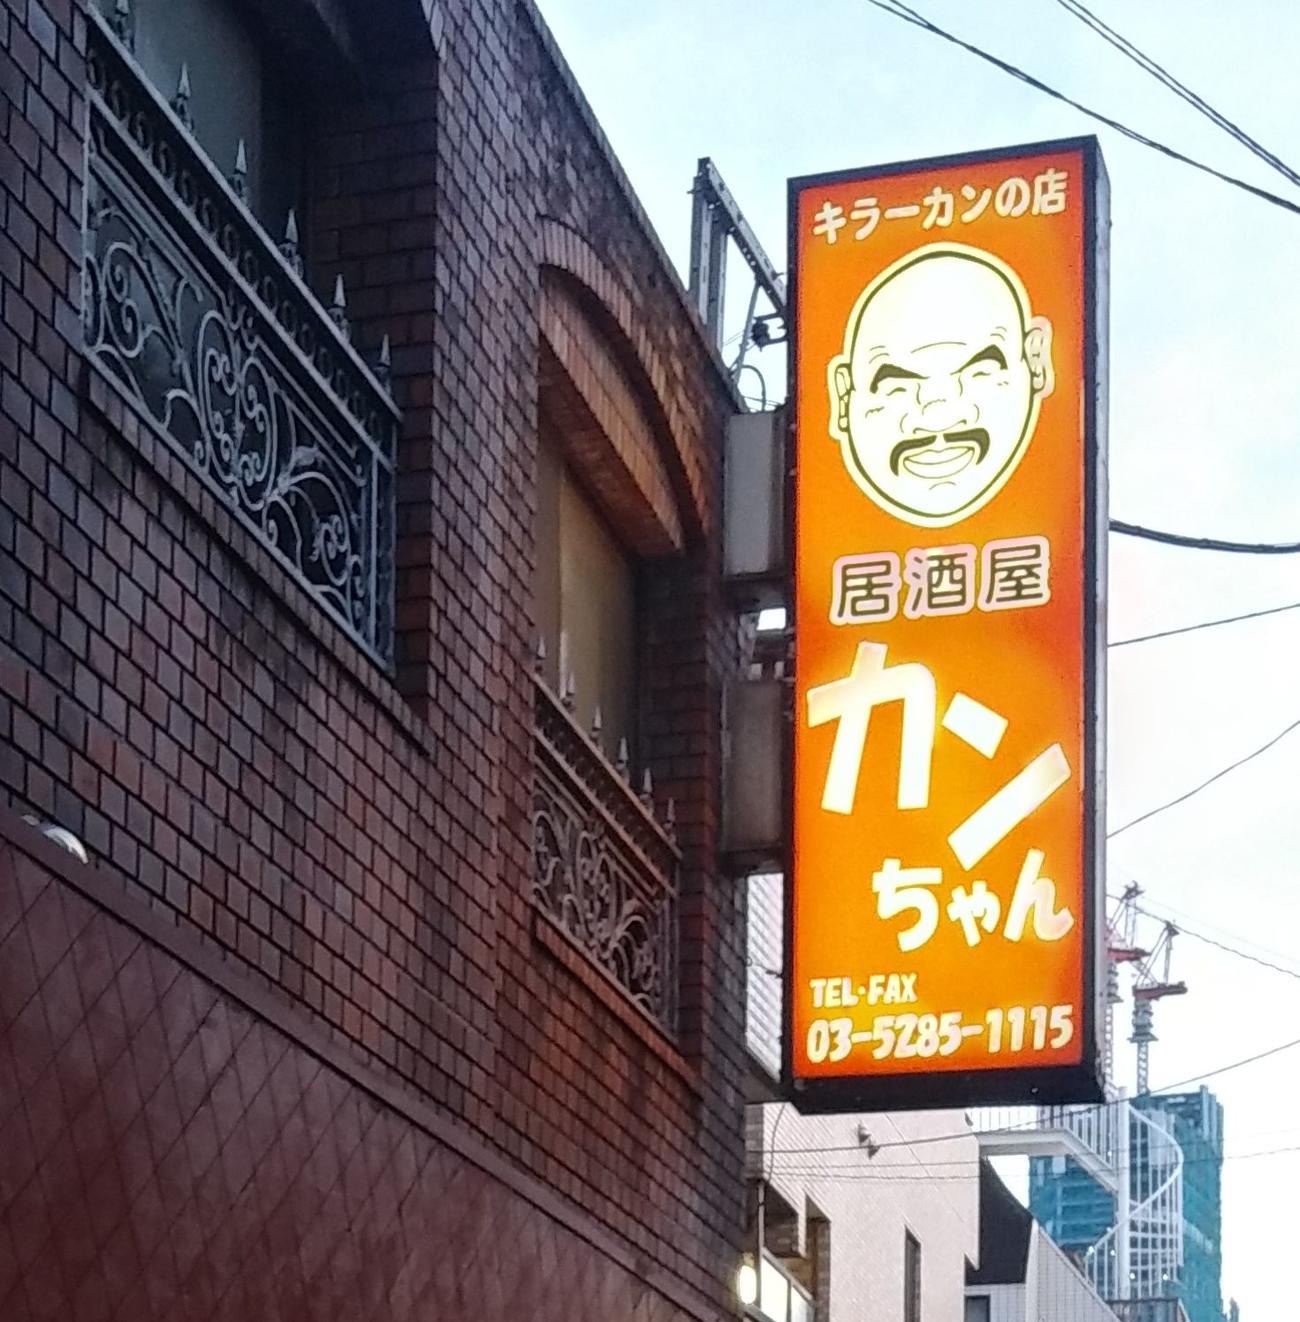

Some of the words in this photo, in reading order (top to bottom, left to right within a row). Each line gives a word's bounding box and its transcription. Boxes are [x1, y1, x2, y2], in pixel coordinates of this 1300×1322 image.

[813, 168, 1069, 245] キラーカンの店
[834, 541, 1045, 620] 居酒屋
[806, 640, 1072, 871] カン
[872, 848, 1075, 952] ちゃん
[806, 1004, 1075, 1064] 03-5285-1115
